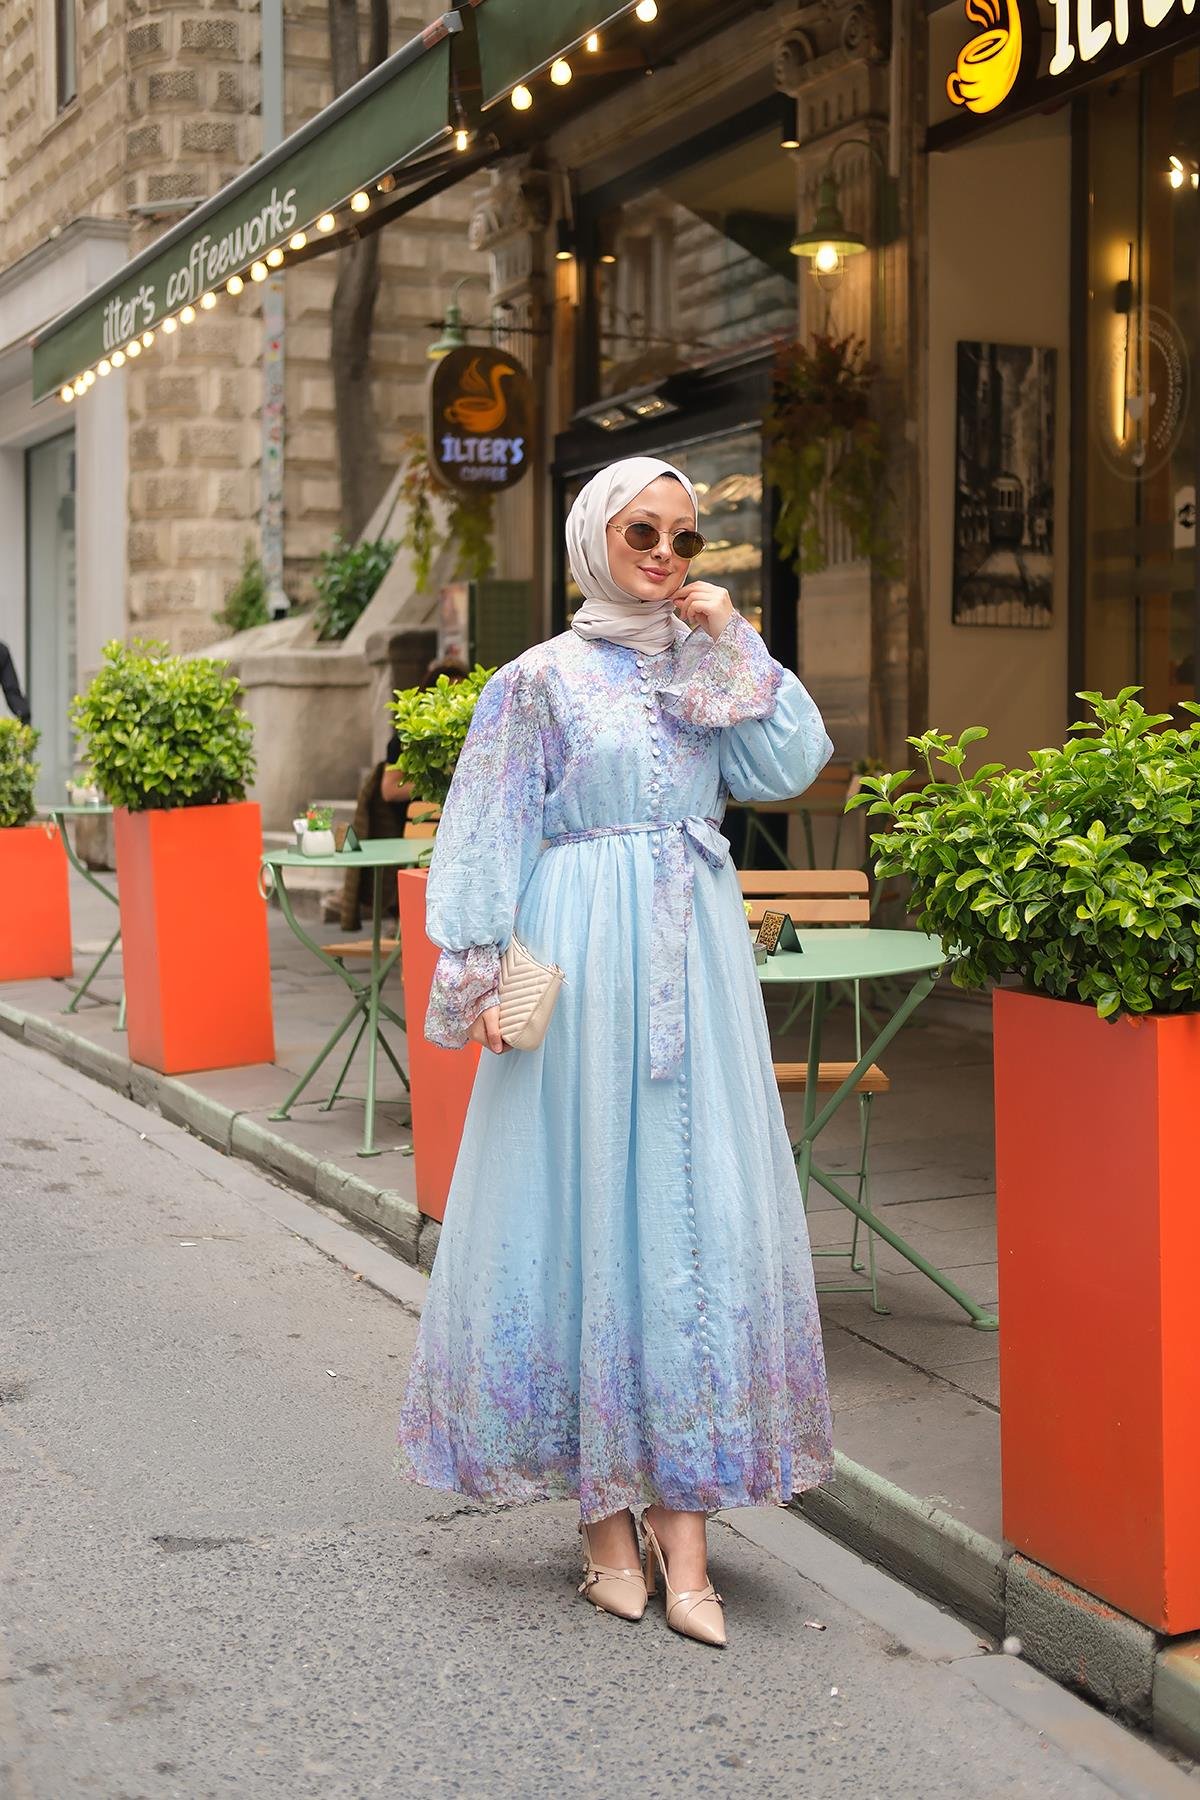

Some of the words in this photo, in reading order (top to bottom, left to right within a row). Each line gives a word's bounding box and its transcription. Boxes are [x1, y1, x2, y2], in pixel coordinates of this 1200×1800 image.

[102, 285, 156, 352] ilter's
[166, 187, 297, 308] coffeeworks
[459, 465, 508, 481] COFFEE
